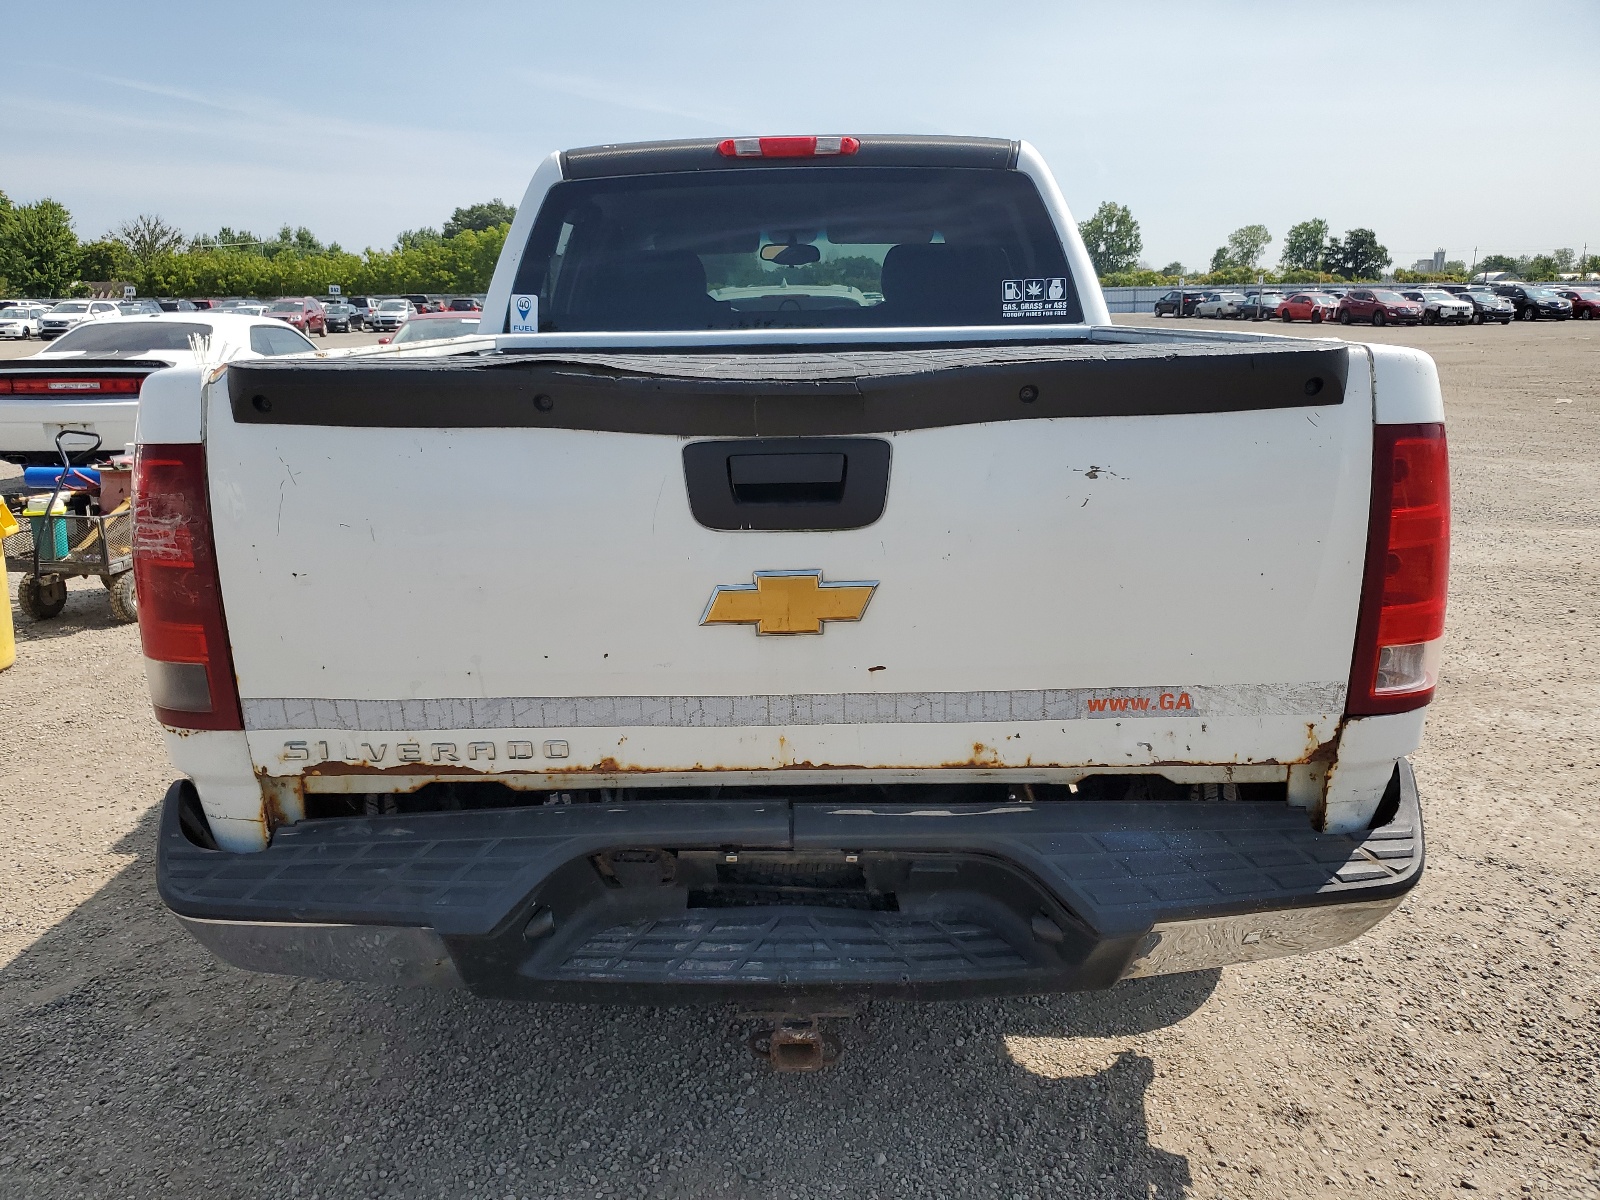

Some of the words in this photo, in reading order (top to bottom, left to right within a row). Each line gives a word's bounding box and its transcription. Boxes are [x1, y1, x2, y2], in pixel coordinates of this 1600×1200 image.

[519, 300, 530, 309] 40
[1002, 303, 1019, 311] GAS,
[1020, 302, 1043, 310] GRASS
[1053, 301, 1067, 309] ASS
[1087, 692, 1191, 713] www.GA
[283, 739, 570, 763] SILVERADO
